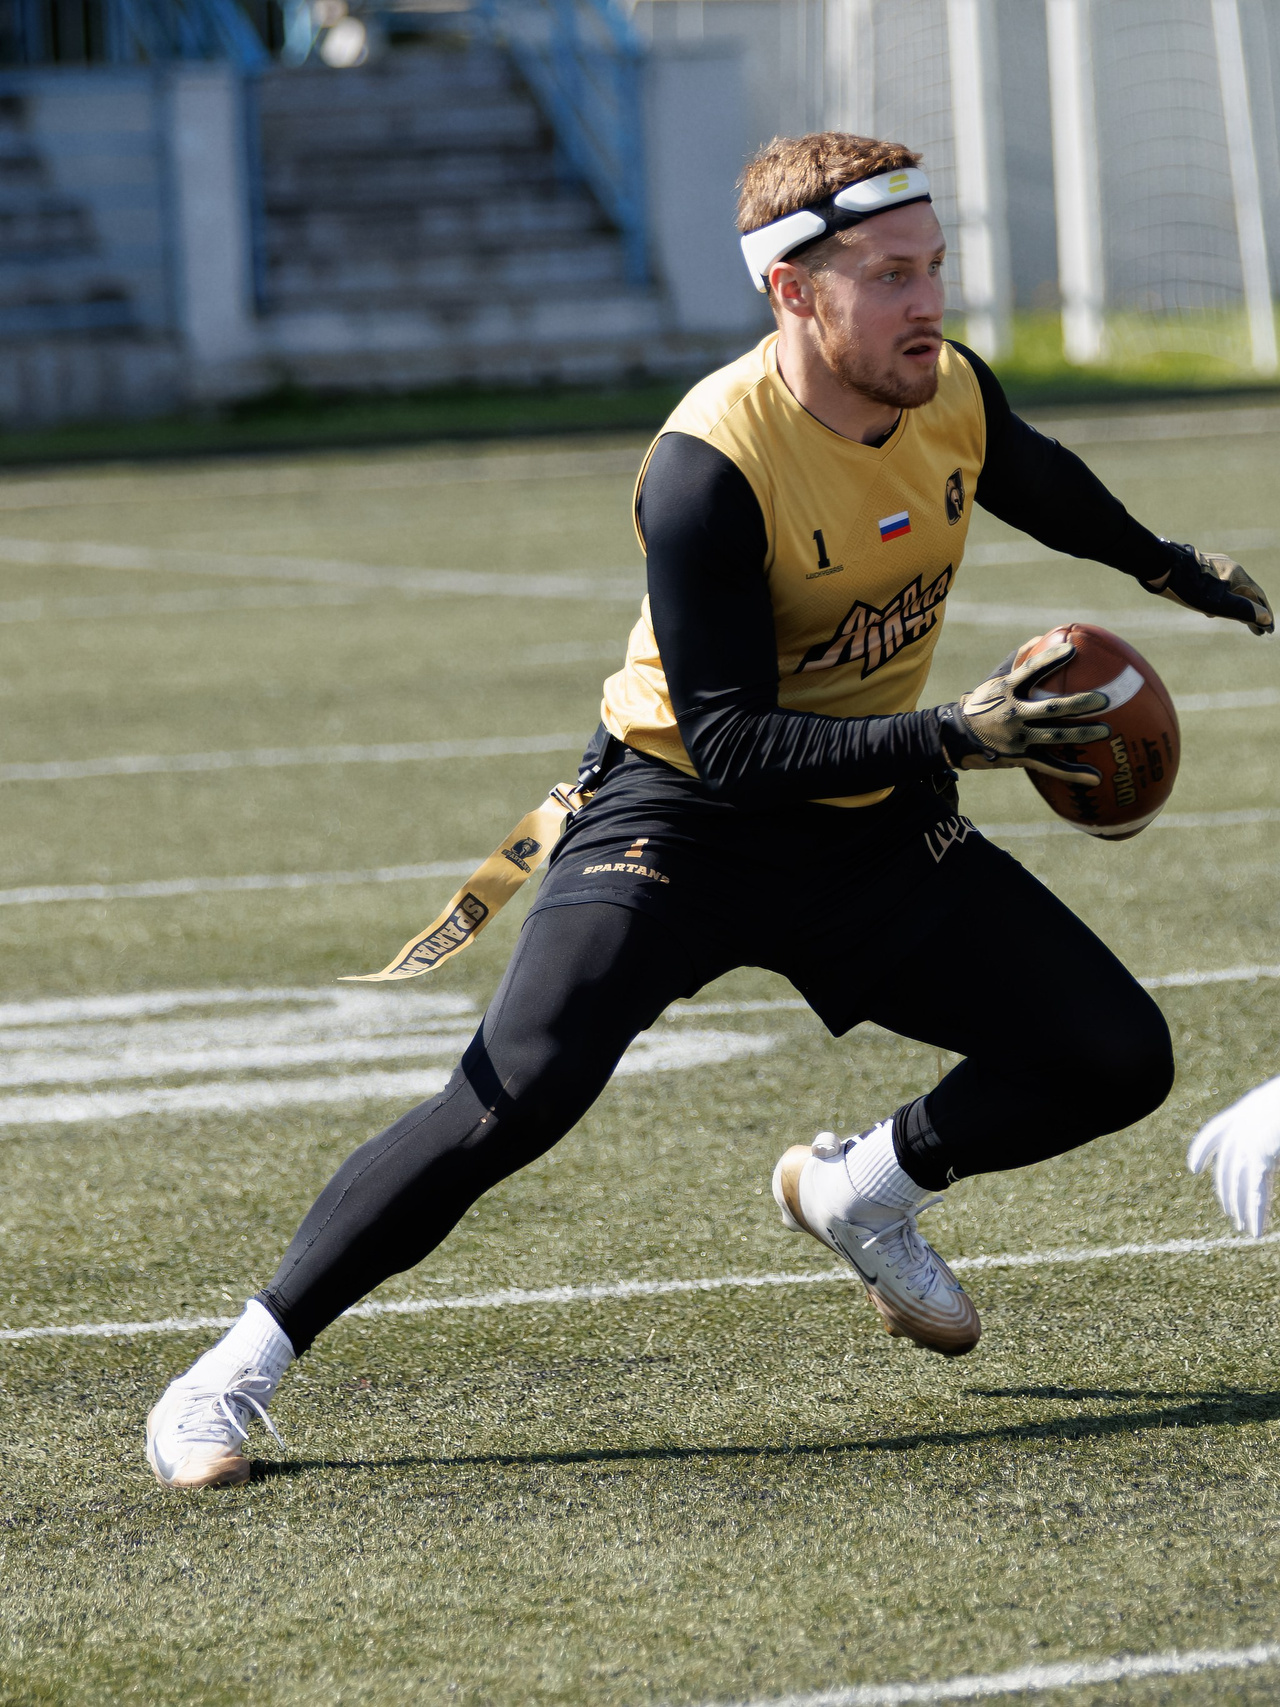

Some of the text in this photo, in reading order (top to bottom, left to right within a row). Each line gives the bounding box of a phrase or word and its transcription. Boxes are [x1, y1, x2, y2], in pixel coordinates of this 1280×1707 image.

[813, 529, 831, 569] 1
[1109, 734, 1138, 807] Wilson
[582, 863, 670, 884] SPARTANS
[389, 897, 485, 976] SPARTANS
